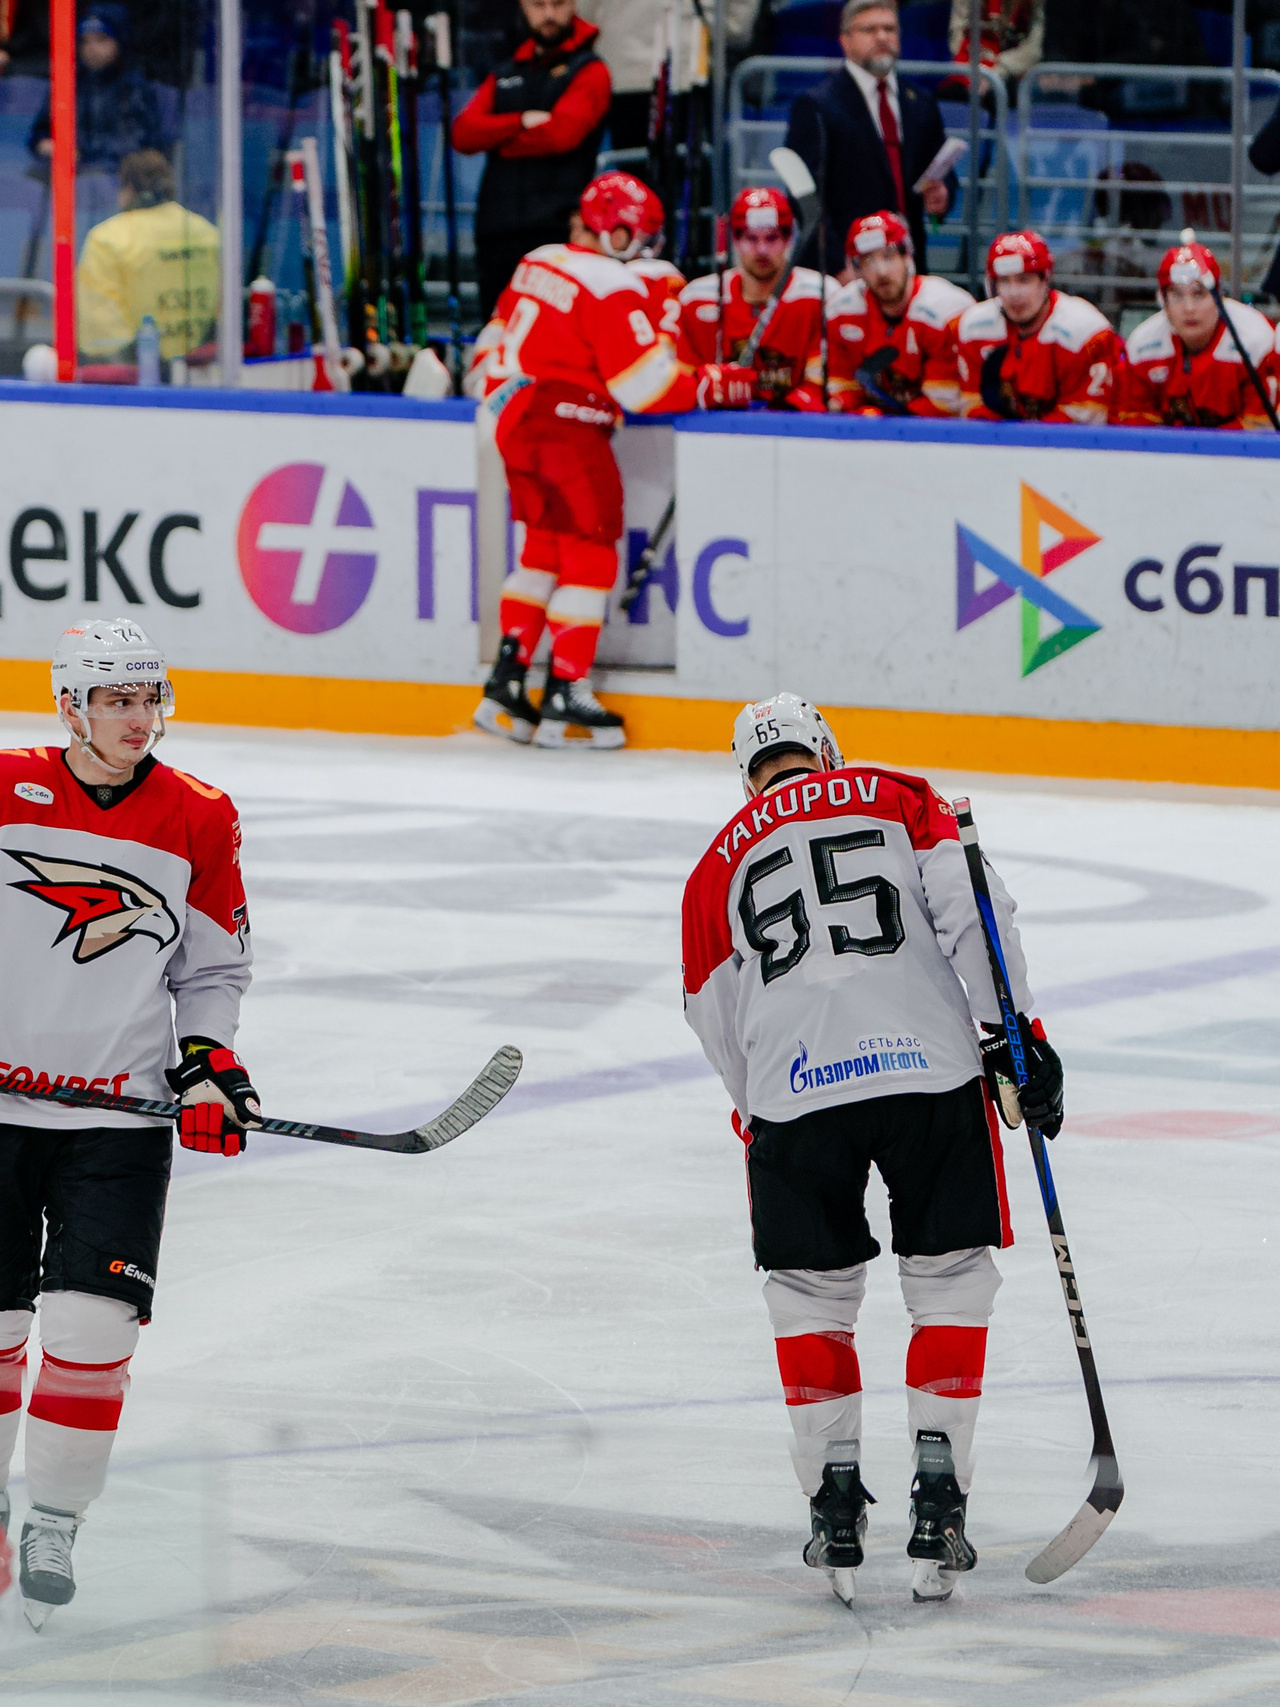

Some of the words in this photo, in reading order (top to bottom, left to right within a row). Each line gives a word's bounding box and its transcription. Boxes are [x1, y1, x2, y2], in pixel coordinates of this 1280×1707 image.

[1123, 544, 1280, 616] сбп
[113, 628, 142, 642] 74
[126, 661, 160, 671] согаз
[755, 718, 780, 744] 65
[716, 775, 880, 865] YAKUPOV
[737, 828, 907, 988] 65
[858, 1037, 894, 1051] СЕТЬ
[896, 1036, 921, 1048] АЗС
[808, 1051, 930, 1090] ГАЗПРОМНЕФТЬ
[1050, 1233, 1091, 1349] CCM
